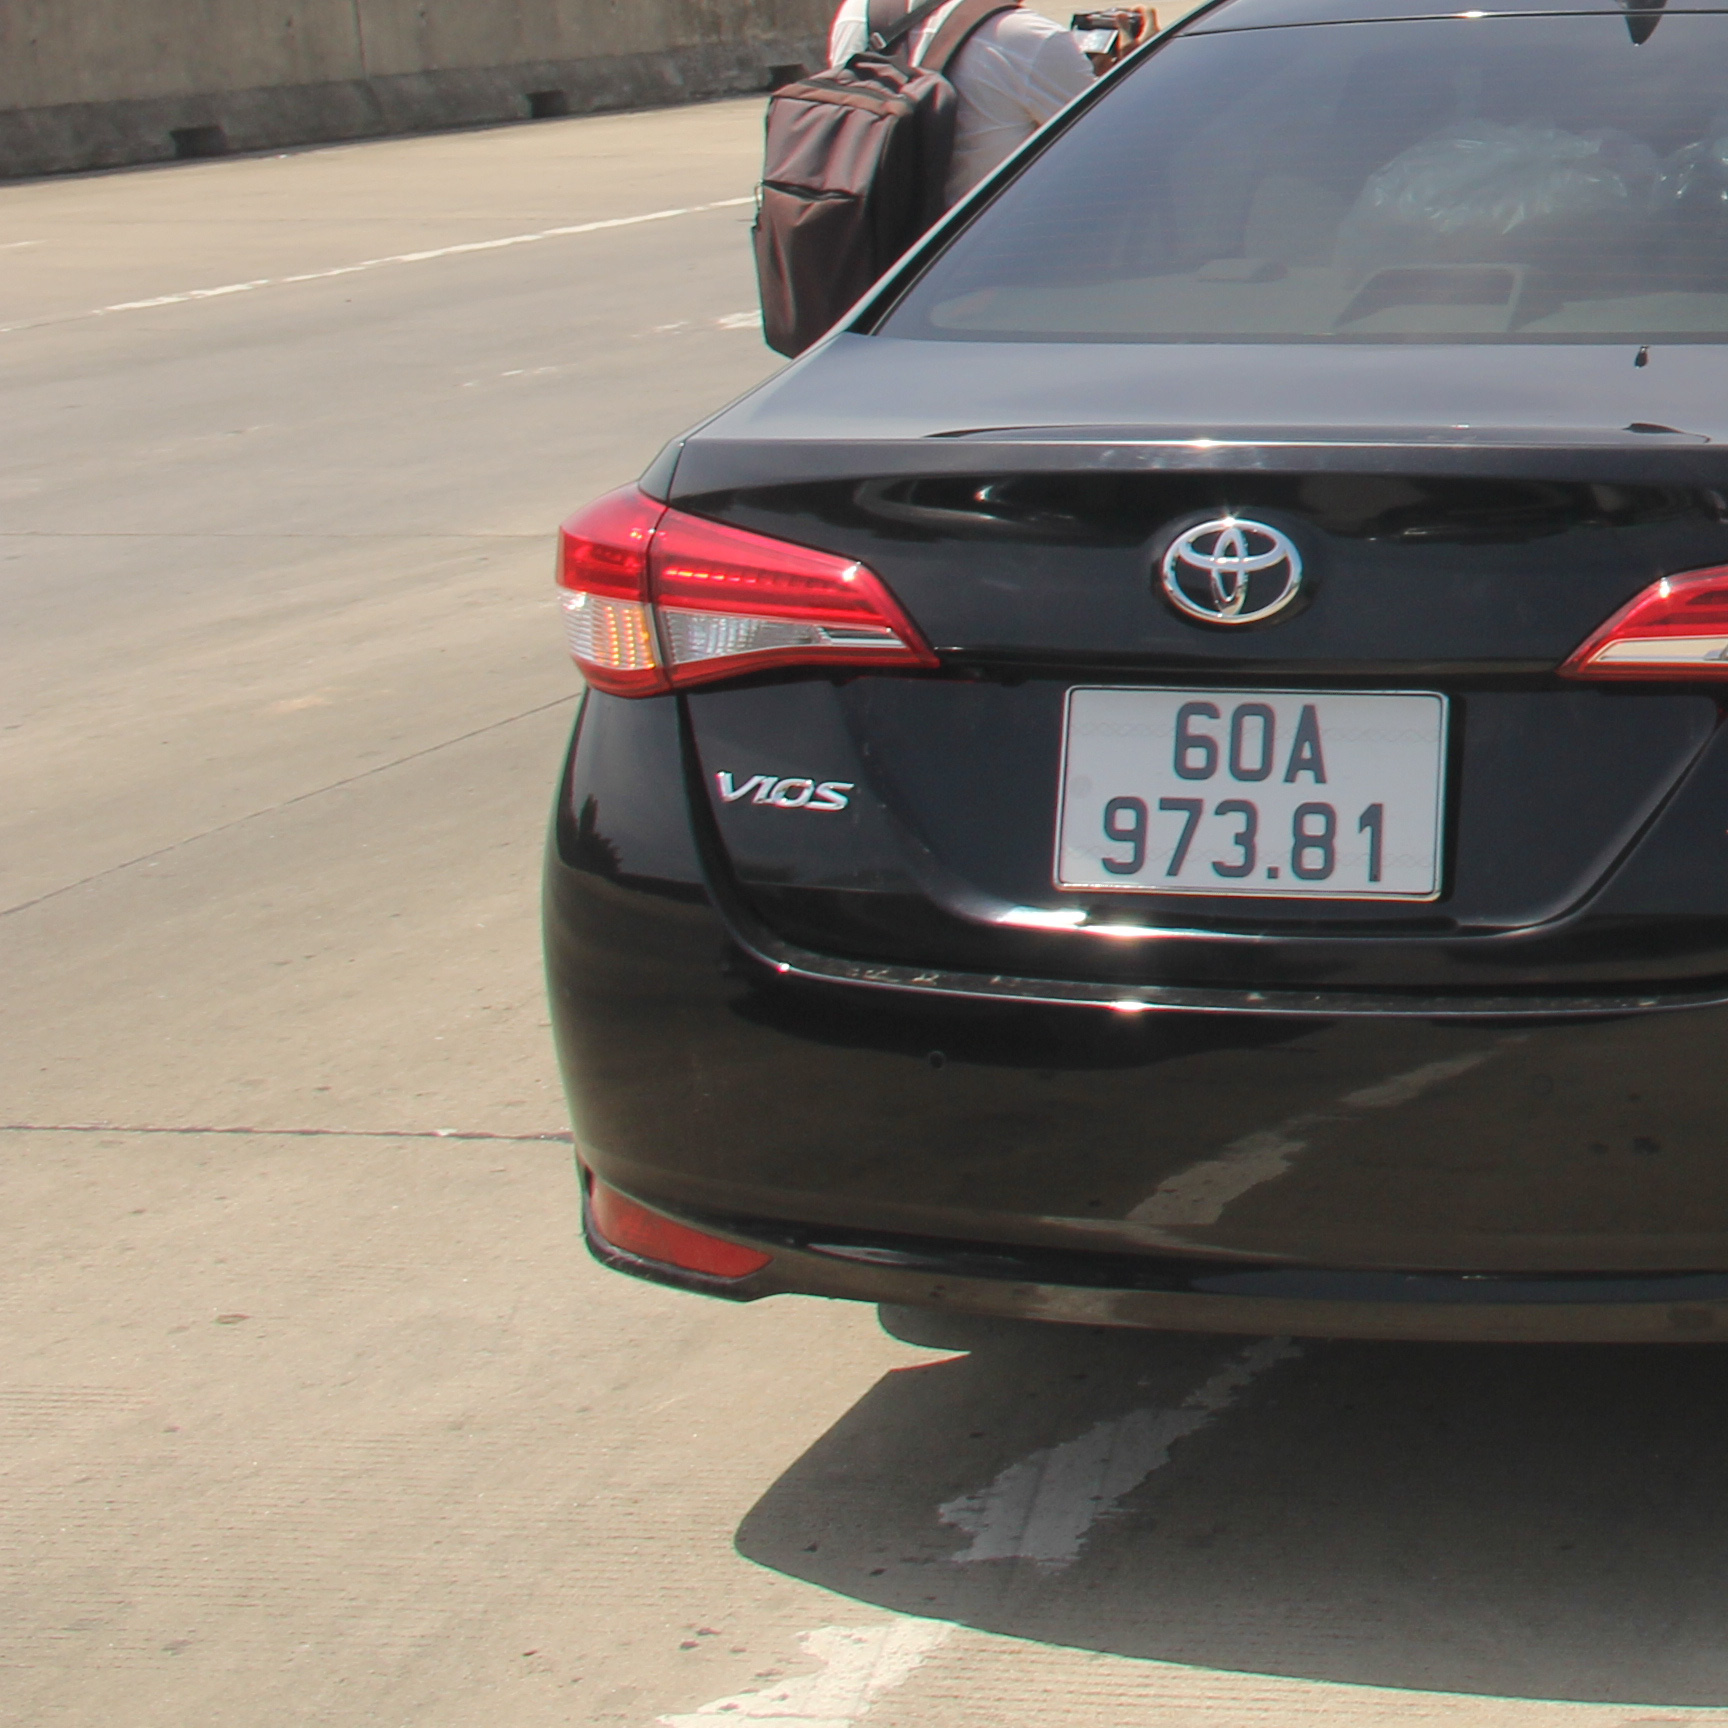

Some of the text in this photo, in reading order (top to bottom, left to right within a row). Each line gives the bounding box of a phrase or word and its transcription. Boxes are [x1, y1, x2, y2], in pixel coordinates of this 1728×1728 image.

[1173, 702, 1328, 785] 60A
[715, 770, 855, 812] VIOS
[1101, 795, 1386, 883] 973.81
